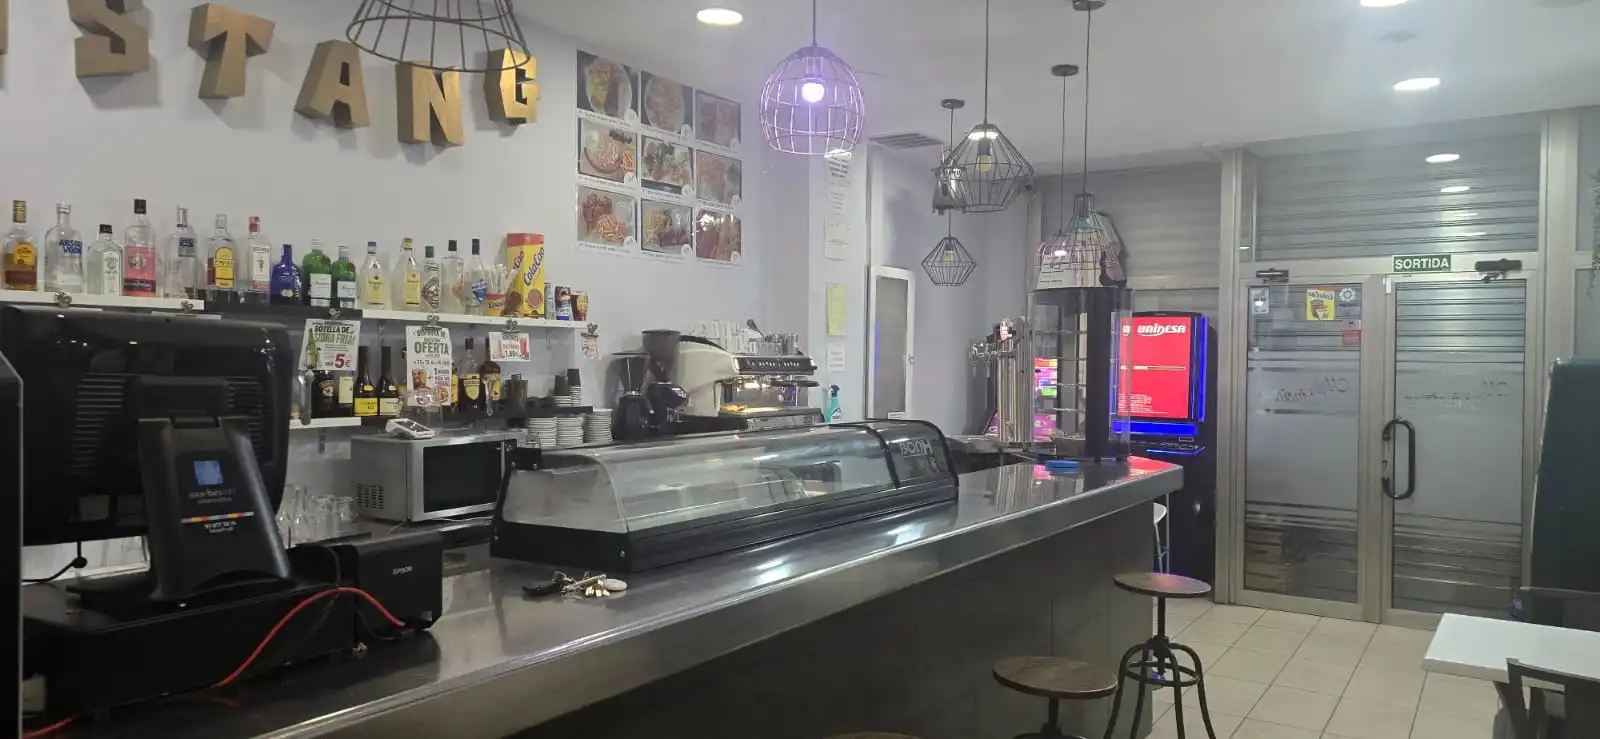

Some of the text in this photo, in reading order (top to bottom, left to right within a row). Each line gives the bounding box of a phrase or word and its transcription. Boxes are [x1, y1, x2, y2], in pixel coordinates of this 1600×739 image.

[0, 0, 538, 147] STANG
[1395, 257, 1449, 270] SORTIDA
[414, 342, 449, 355] OFERTA
[392, 565, 413, 575] EPSON
